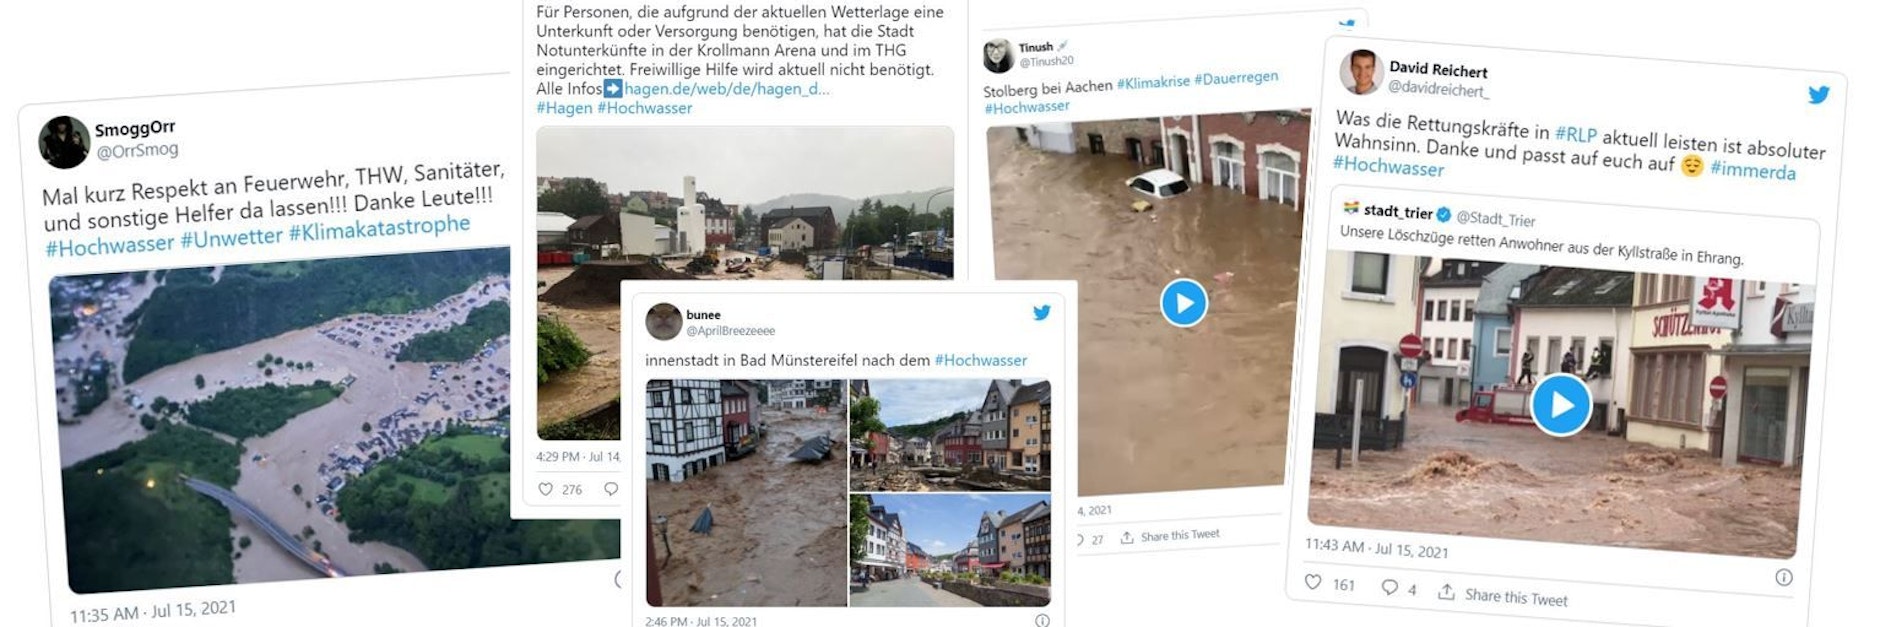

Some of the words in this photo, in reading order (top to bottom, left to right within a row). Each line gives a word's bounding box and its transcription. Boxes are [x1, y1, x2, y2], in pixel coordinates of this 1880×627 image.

[536, 4, 560, 19] Für
[563, 4, 633, 20] Personen,
[637, 4, 660, 19] die
[663, 4, 729, 22] aufgrund
[733, 4, 758, 19] der
[761, 4, 827, 19] aktuellen
[830, 4, 910, 22] Wetterlage
[913, 4, 944, 19] eine
[536, 23, 614, 38] Unterkunft
[617, 23, 652, 38] oder
[654, 24, 738, 41] Versorgung
[742, 23, 819, 41] benötigen,
[823, 23, 847, 38] hat
[850, 23, 873, 38] die
[877, 23, 915, 38] Stadt
[536, 42, 647, 57] Notunterkünfte
[651, 43, 664, 57] in
[668, 42, 693, 57] der
[697, 43, 770, 57] Krollmann
[774, 43, 816, 57] Arena
[821, 42, 848, 57] und
[853, 43, 871, 57] im
[875, 43, 907, 57] THG
[1018, 41, 1054, 53] Tinush
[536, 62, 625, 79] eingerichtet.
[630, 62, 701, 79] Freiwillige
[706, 61, 739, 76] Hilfe
[742, 62, 774, 76] wird
[778, 61, 825, 76] aktuell
[830, 62, 866, 76] nicht
[869, 61, 934, 79] benötigt.
[1020, 55, 1074, 69] @Tinush20
[1389, 60, 1429, 75] David
[1431, 63, 1489, 80] Reichert
[536, 81, 563, 96] Alle
[568, 81, 604, 97] Infos
[983, 84, 1038, 99] Stolberg
[1041, 82, 1062, 95] bei
[1065, 79, 1113, 94] Aachen
[1117, 75, 1191, 90] #Klimakrise
[1194, 72, 1279, 86] #Dauerregen
[1388, 79, 1489, 100] @davidreichert_
[536, 101, 593, 117] #Hagen
[597, 100, 693, 115] #Hochwasser
[985, 101, 1070, 115] #Hochwasser
[94, 119, 176, 140] SmoggOrr
[1336, 109, 1371, 127] Was
[1375, 111, 1402, 130] die
[1407, 114, 1530, 139] Rettungskräfte
[1534, 124, 1550, 140] in
[1554, 126, 1598, 143] #RLP
[1602, 128, 1658, 148] aktuell
[1663, 132, 1718, 153] leisten
[1722, 137, 1743, 155] ist
[1746, 139, 1827, 161] absoluter
[97, 143, 179, 162] @OrrSmog
[1334, 131, 1421, 154] Wahnsinn.
[1426, 138, 1480, 158] Danke
[1484, 144, 1517, 161] und
[1522, 150, 1566, 166] passt
[1570, 149, 1599, 166] auf
[1602, 153, 1643, 170] euch
[1647, 155, 1675, 172] auf
[1710, 159, 1797, 181] #immerda
[1333, 154, 1445, 178] #Hochwasser
[42, 185, 78, 207] Mal
[84, 185, 126, 204] kurz
[131, 178, 209, 204] Respekt
[214, 181, 238, 195] an
[244, 169, 350, 193] Feuerwehr,
[354, 165, 408, 186] THW,
[414, 161, 505, 182] Sanitäter,
[44, 211, 81, 233] und
[87, 208, 169, 231] sonstige
[175, 202, 234, 224] Helfer
[239, 200, 264, 220] da
[270, 195, 347, 218] lassen!!!
[354, 190, 415, 212] Danke
[421, 185, 493, 208] Leute!!!
[1363, 204, 1435, 221] stadt_trier
[1456, 210, 1536, 228] @Stadt_Trier
[46, 236, 175, 258] #Hochwasser
[180, 229, 284, 249] #Unwetter
[289, 214, 471, 242] #Klimakatastrophe
[1340, 224, 1385, 240] Unsere
[1387, 227, 1455, 248] Löschzüge
[1457, 234, 1496, 248] retten
[1498, 236, 1564, 253] Anwohner
[1567, 243, 1590, 255] aus
[1592, 242, 1615, 256] der
[1618, 245, 1678, 261] Kyllstraße
[1681, 248, 1693, 262] in
[1697, 250, 1744, 270] Ehrang.
[686, 309, 722, 322] bunee
[686, 325, 776, 338] @AprilBreezeeee
[645, 353, 719, 367] innenstadt
[723, 353, 736, 367] in
[740, 353, 766, 367] Bad
[771, 352, 858, 367] Münstereifel
[862, 353, 895, 367] nach
[899, 353, 931, 367] dem
[935, 353, 1028, 367] #Hochwasser
[536, 451, 559, 462] 4:29
[562, 451, 580, 462] PM
[589, 451, 603, 462] Jul
[562, 484, 583, 495] 276
[1088, 505, 1112, 516] 2021
[1092, 535, 1104, 545] 27
[1141, 532, 1169, 542] Share
[1171, 530, 1189, 540] this
[1191, 529, 1220, 539] Tweet
[1306, 538, 1339, 551] 11:43
[1342, 540, 1365, 553] AM
[1375, 543, 1392, 555] Jul
[1397, 544, 1414, 558] 15,
[1417, 545, 1448, 559] 2021
[1334, 578, 1354, 591] 161
[1408, 584, 1416, 596] 4
[1465, 588, 1502, 603] Share
[1505, 591, 1528, 605] this
[1532, 592, 1568, 607] Tweet
[71, 608, 109, 624] 11:35
[113, 605, 139, 621] AM
[152, 603, 171, 619] Jul
[176, 602, 197, 617] 15,
[201, 599, 235, 616] 2021
[645, 616, 668, 627] 2:46
[670, 617, 688, 627] PM
[697, 617, 710, 627] Jul
[715, 616, 729, 627] 15,
[732, 616, 756, 627] 2021
